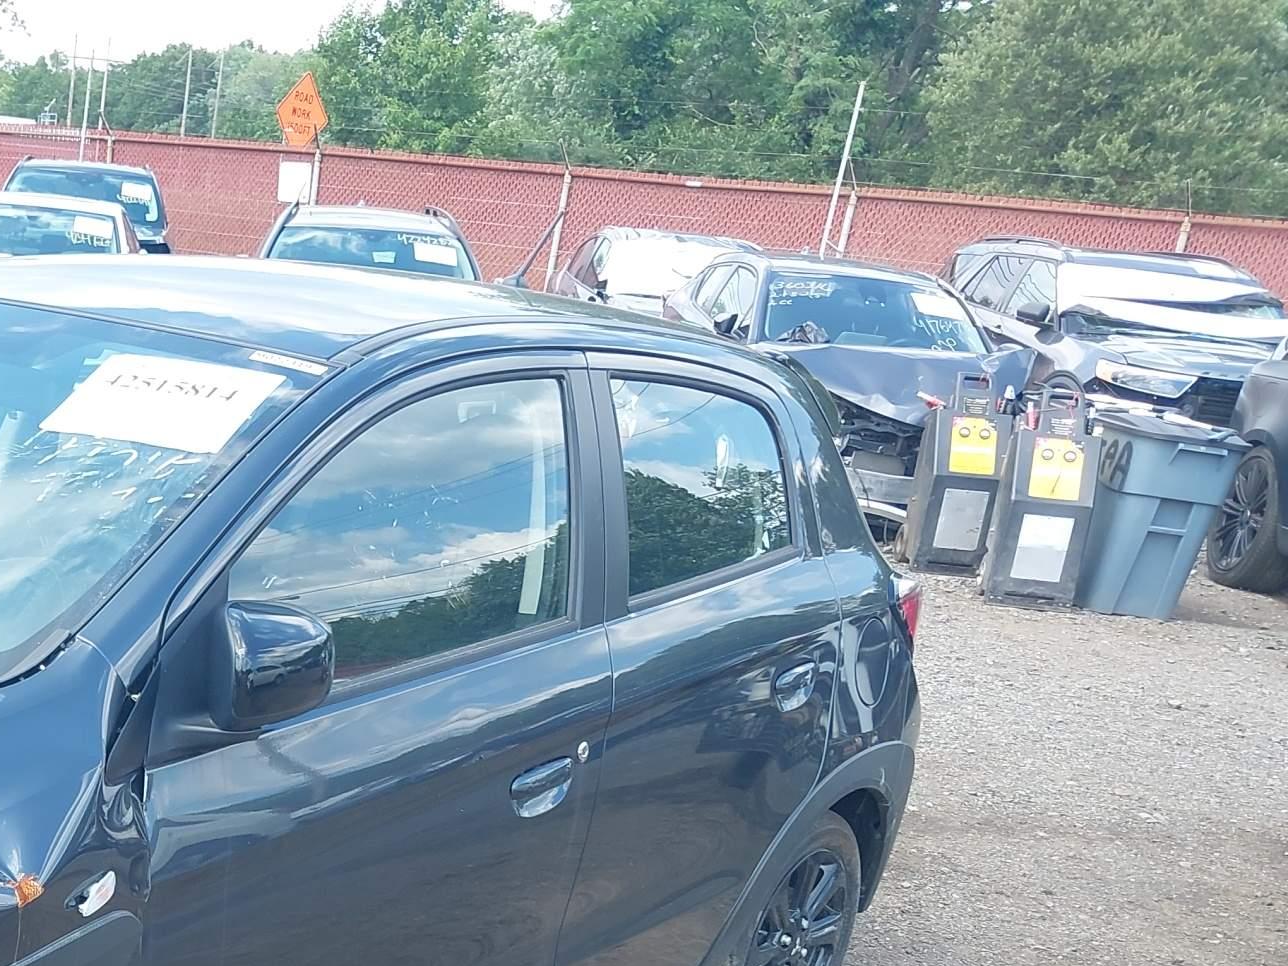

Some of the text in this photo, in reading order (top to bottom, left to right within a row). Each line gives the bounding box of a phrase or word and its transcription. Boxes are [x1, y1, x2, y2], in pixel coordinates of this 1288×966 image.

[294, 90, 314, 105] ROAD
[291, 107, 311, 121] WORK
[1101, 438, 1134, 491] AA
